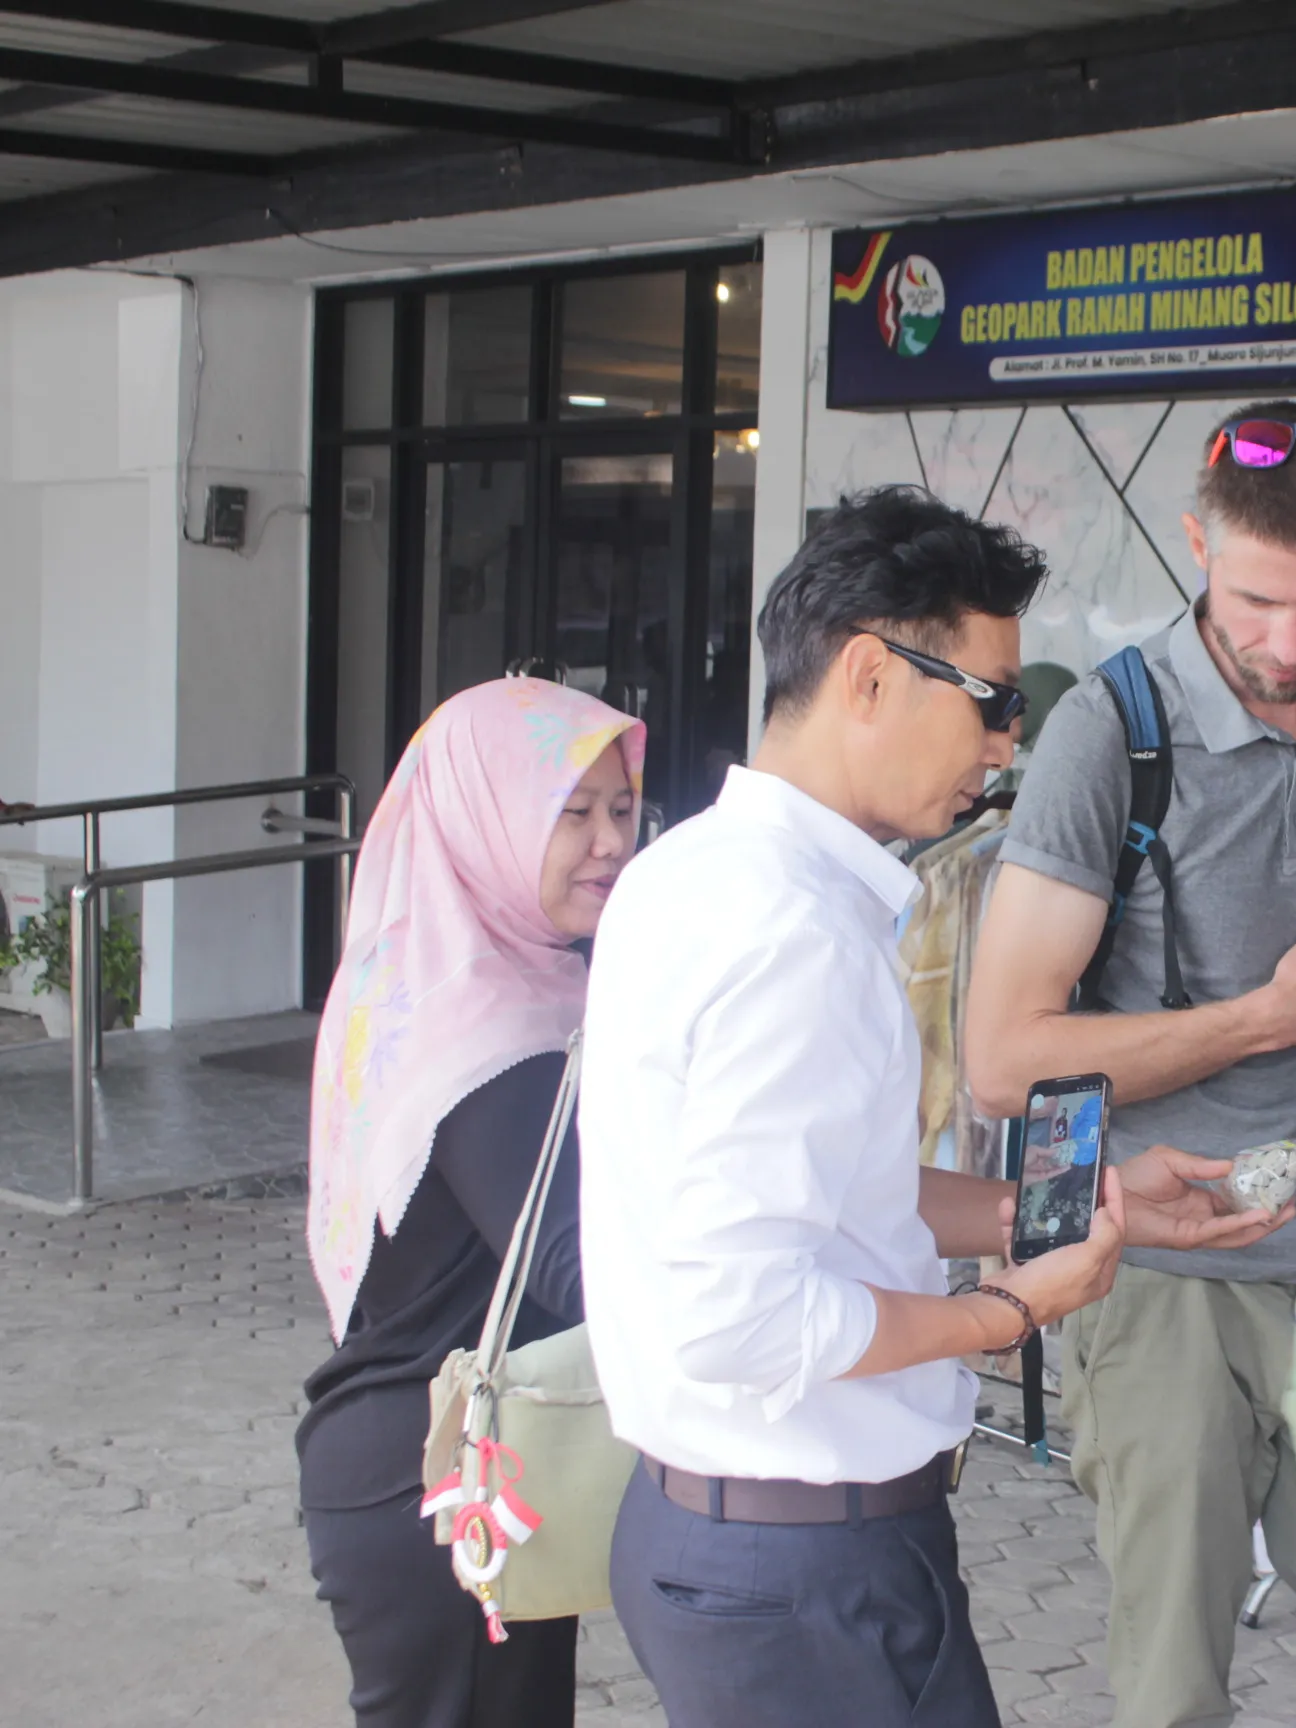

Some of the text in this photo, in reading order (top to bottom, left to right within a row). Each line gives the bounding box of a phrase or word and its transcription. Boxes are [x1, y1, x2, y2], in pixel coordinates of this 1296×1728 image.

[1046, 232, 1264, 290] BADAN PENGELOLA
[961, 298, 1062, 345] GEOPARK
[1066, 291, 1146, 338] RANAH
[1150, 284, 1249, 333] MINANG
[1004, 359, 1043, 373] Alamat
